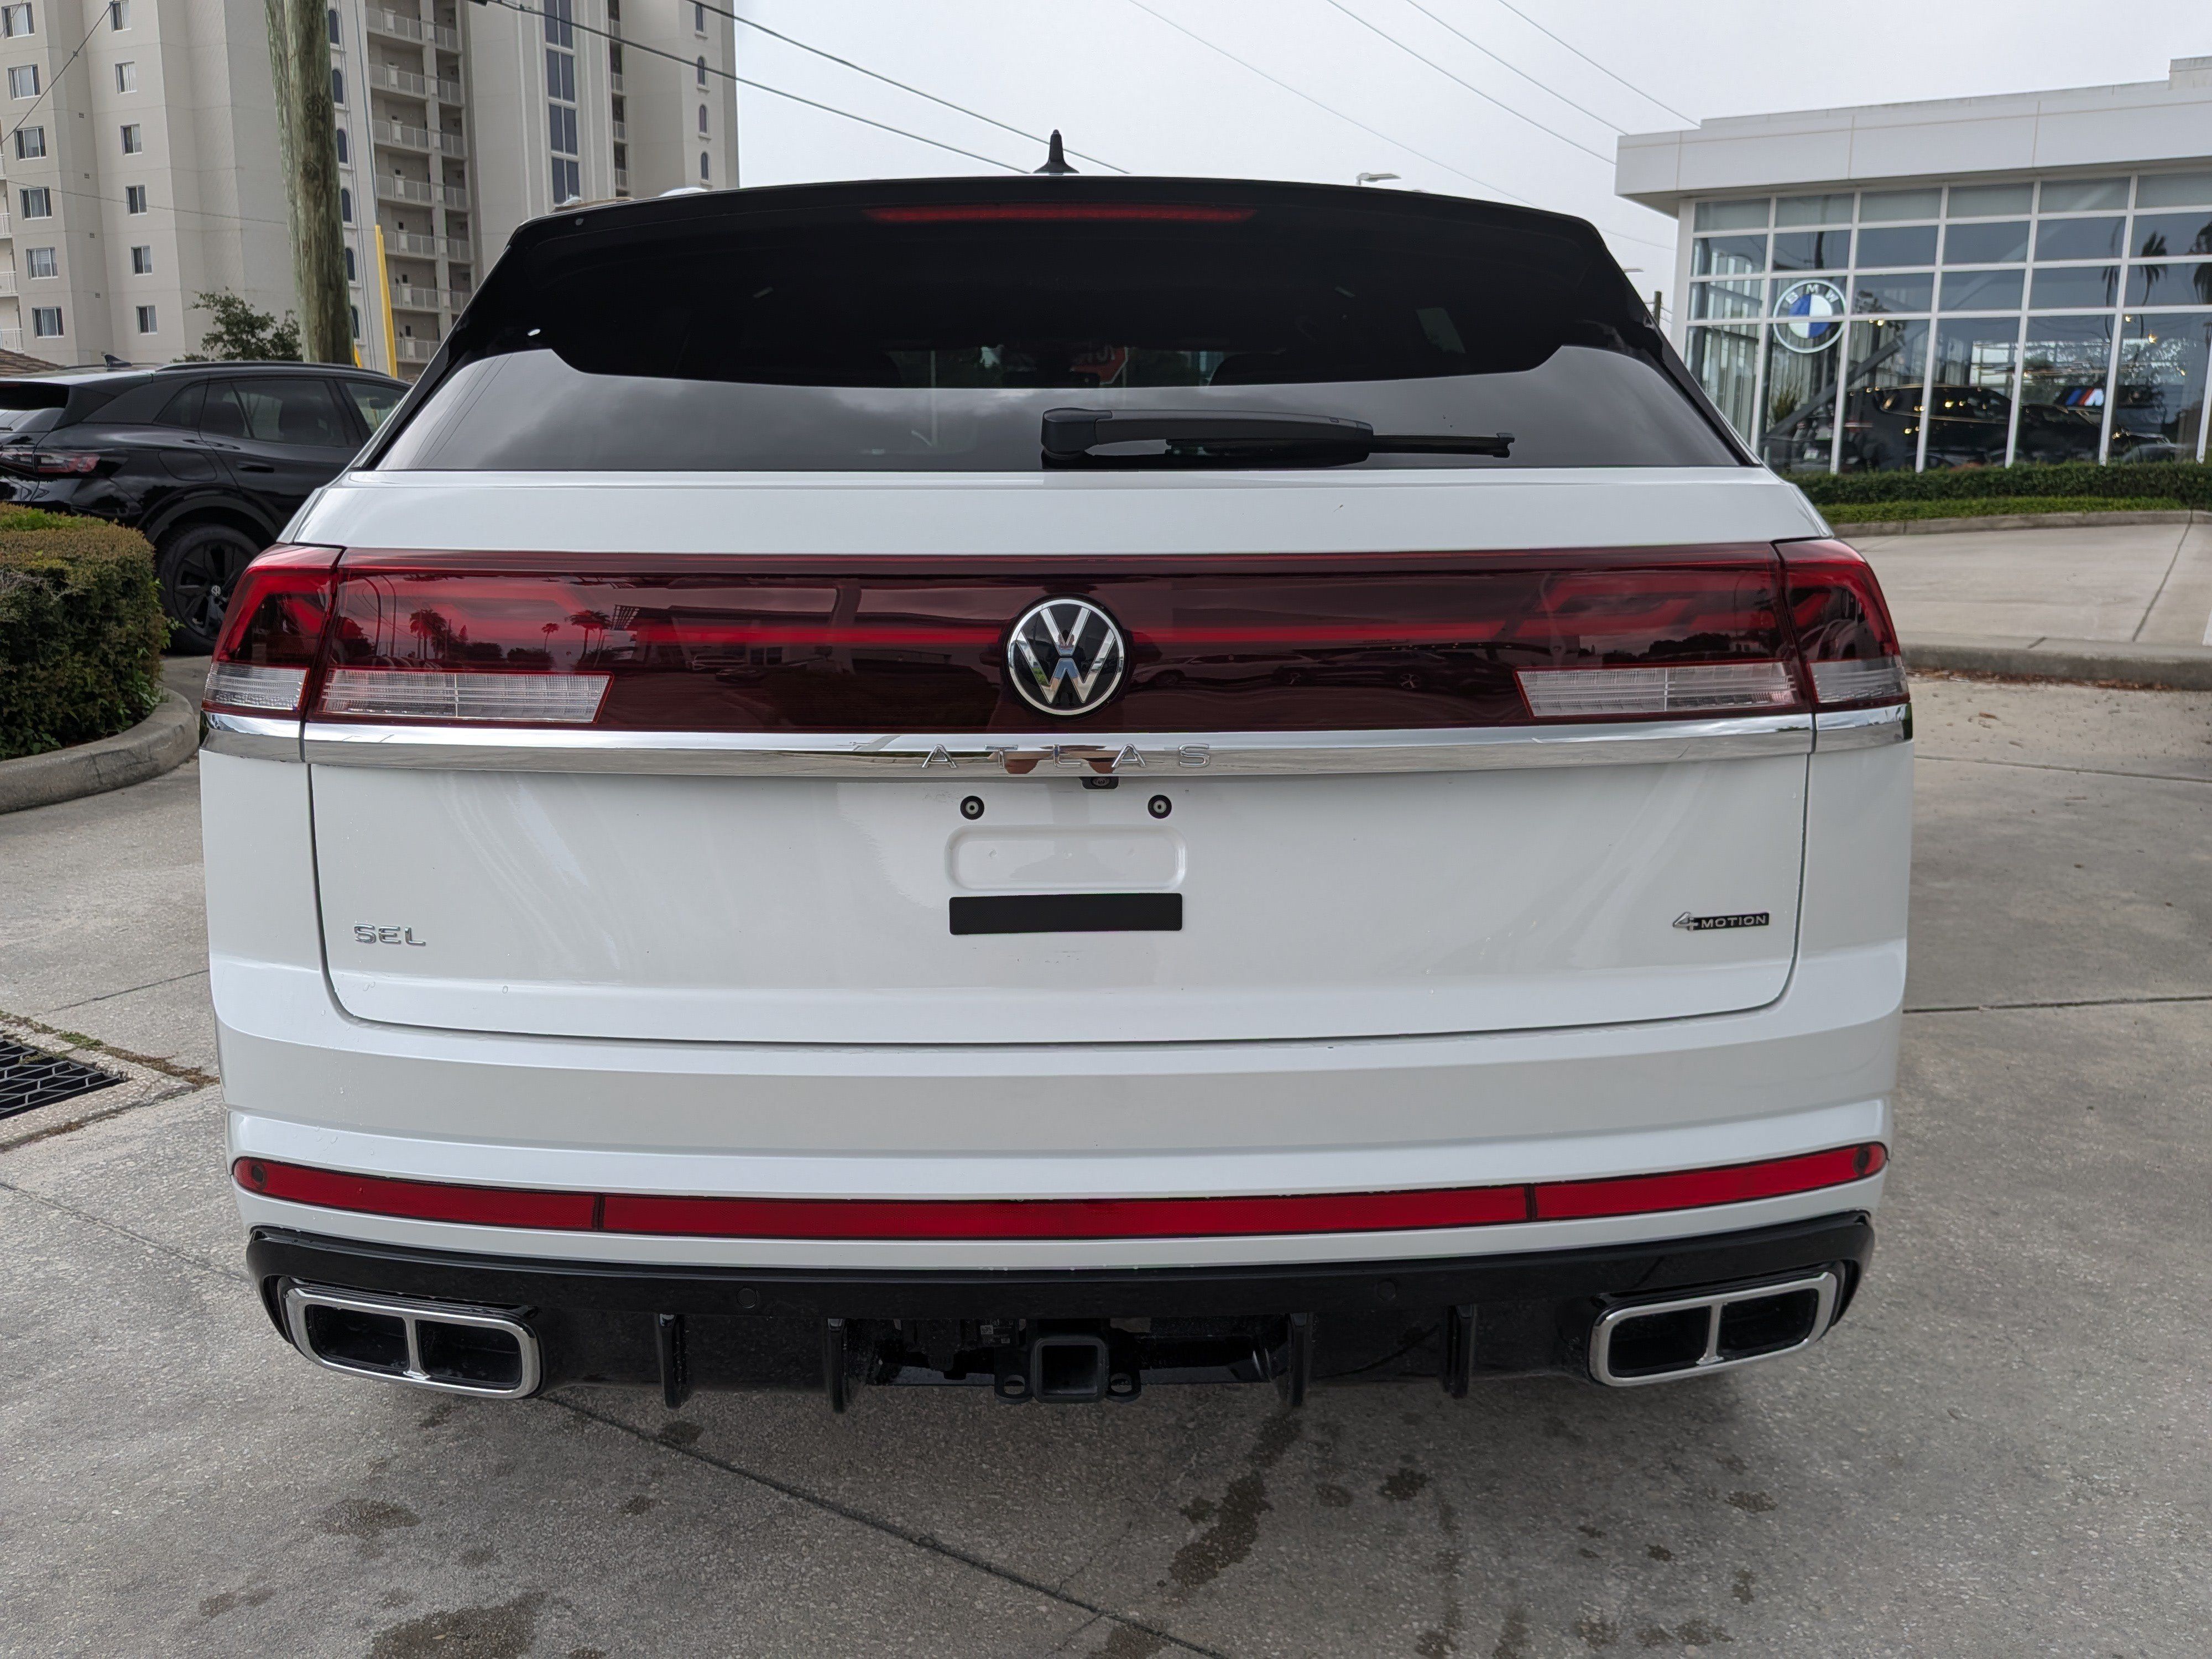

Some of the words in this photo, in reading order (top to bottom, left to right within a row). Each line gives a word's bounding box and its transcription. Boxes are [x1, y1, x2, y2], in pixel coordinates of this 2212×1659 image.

[1785, 284, 1839, 304] BMW
[1015, 607, 1116, 704] VW
[921, 743, 1211, 769] ATLAS
[354, 923, 426, 946] SEL
